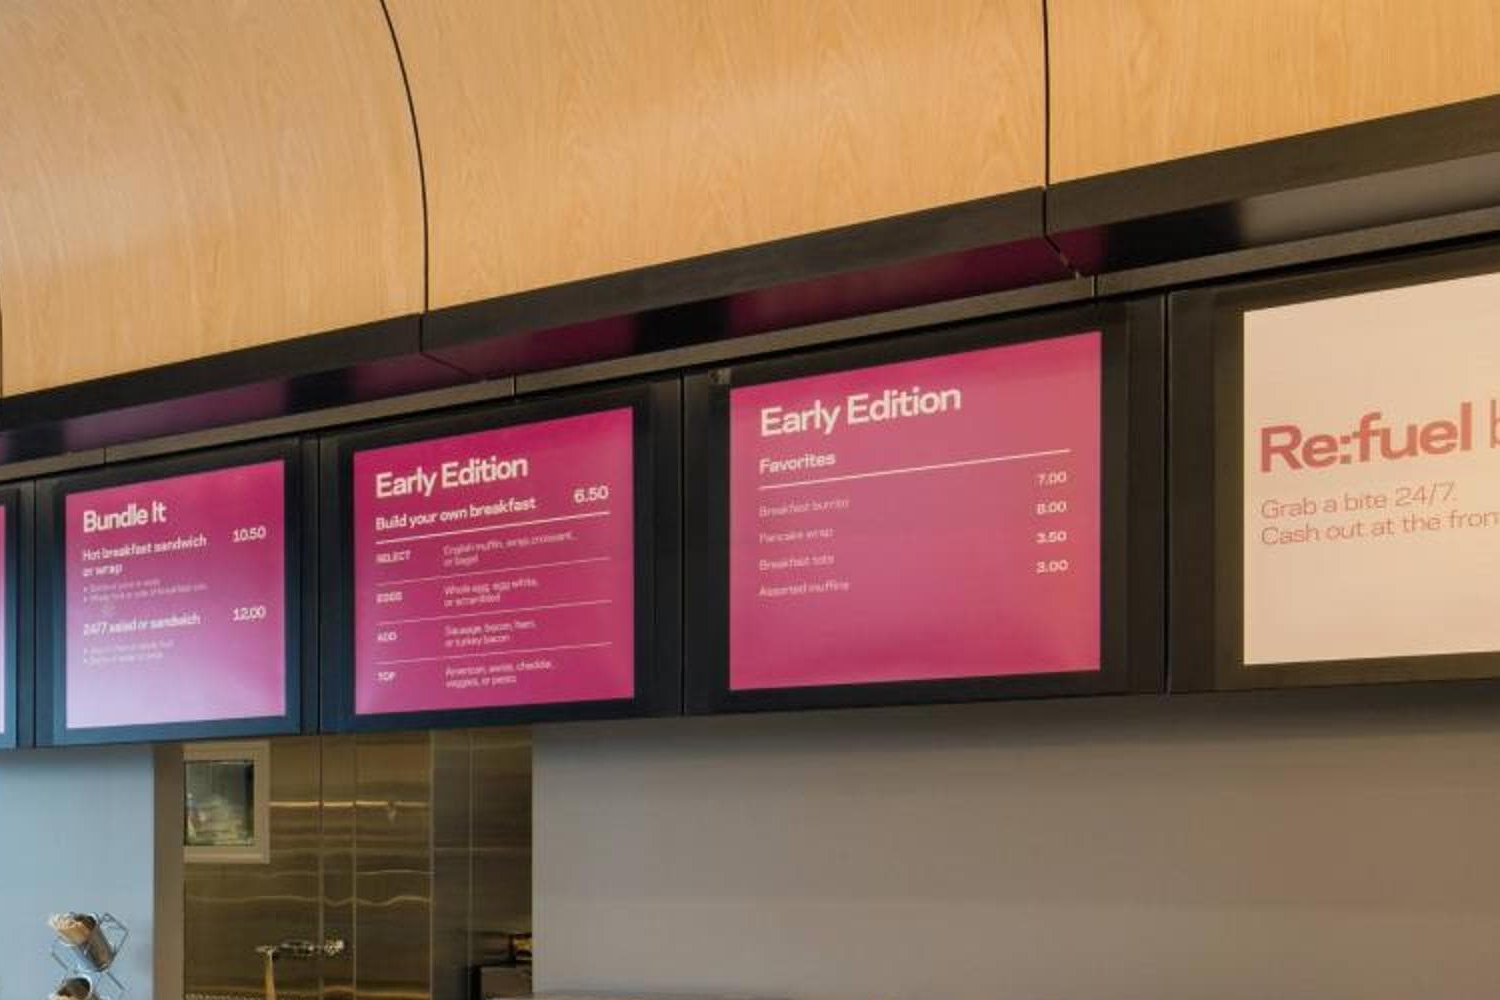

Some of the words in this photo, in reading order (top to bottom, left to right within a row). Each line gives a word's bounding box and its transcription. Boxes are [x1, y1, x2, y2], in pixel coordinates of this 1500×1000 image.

[760, 400, 840, 437] Early
[846, 386, 962, 425] Edition
[1258, 400, 1473, 474] Re:fuel
[375, 466, 437, 498] Early
[441, 454, 529, 488] Edition
[759, 452, 837, 475] Favorites
[573, 485, 609, 504] 6.50
[1260, 496, 1317, 520] Grab
[1322, 498, 1338, 513] a
[1343, 493, 1388, 512] bite
[82, 502, 149, 534] Bundle
[151, 500, 168, 524] It
[375, 514, 407, 531] Build
[408, 511, 437, 528] your
[439, 507, 468, 522] own
[469, 497, 537, 518] breakfast
[1260, 522, 1320, 546] Cash
[1324, 520, 1366, 541] out
[1370, 517, 1396, 538] at
[1402, 512, 1442, 532] the
[153, 533, 208, 554] sandwich
[232, 525, 267, 543] 10.50
